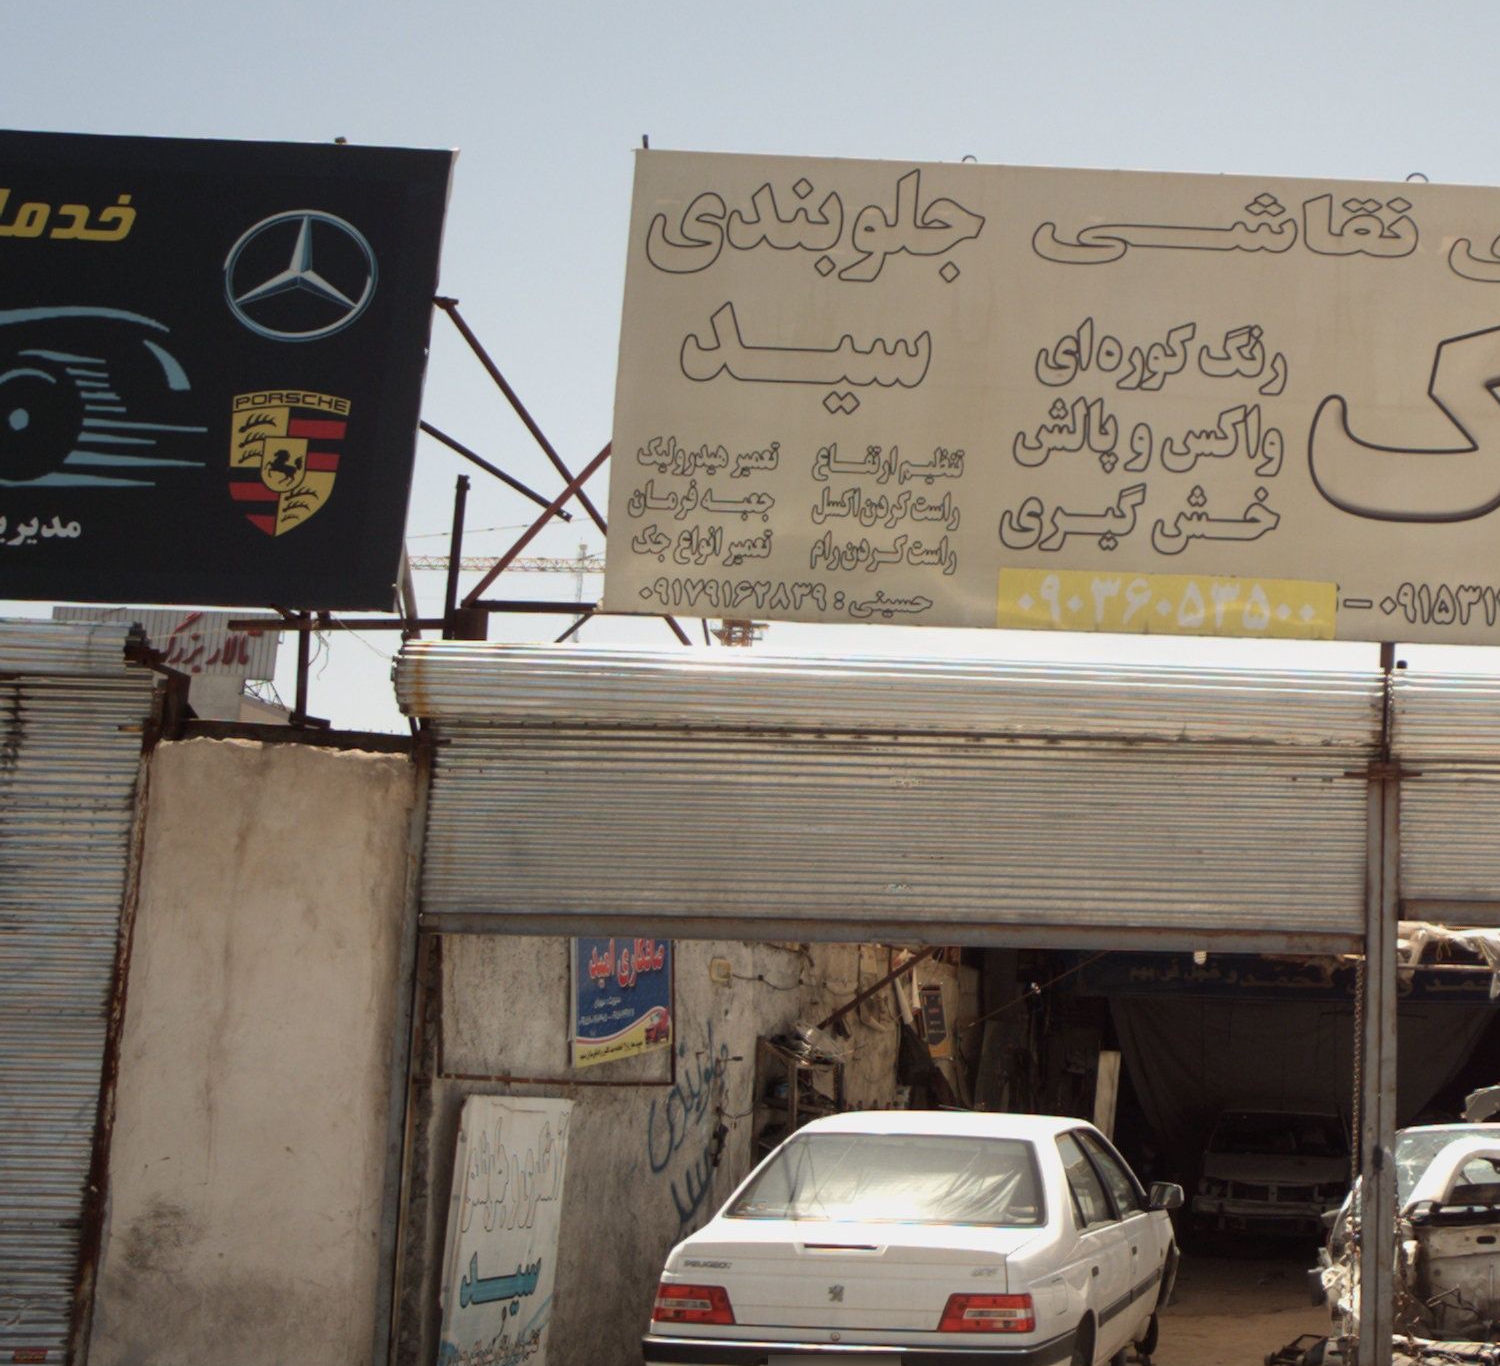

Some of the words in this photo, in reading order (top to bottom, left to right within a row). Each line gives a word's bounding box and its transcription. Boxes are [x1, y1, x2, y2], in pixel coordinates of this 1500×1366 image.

[647, 169, 985, 282] جلوبندی
[1032, 192, 1419, 264] نقاشی
[681, 302, 930, 415] سید
[1199, 325, 1287, 396] رنگ
[236, 392, 348, 413] PORSCHE
[1013, 397, 1119, 473] پالش
[1124, 423, 1153, 472] و
[1161, 404, 1284, 476] واکس
[637, 436, 729, 475] هیدرولیک
[730, 442, 781, 478] تعمیر
[812, 443, 897, 483] ارتفاع
[899, 447, 965, 484] تنظیم
[627, 479, 699, 519] فرمان
[701, 488, 775, 522] جعبه
[811, 487, 860, 525] اکسل
[859, 491, 912, 528] کردن
[910, 492, 960, 530] راست
[999, 483, 1146, 551] گیری
[1152, 486, 1280, 555] خش
[632, 524, 671, 562] جک
[674, 526, 723, 565] انواع
[723, 530, 773, 566] تعمیر
[810, 530, 841, 570] رام
[841, 534, 908, 572] کردن
[907, 536, 957, 574] راست
[639, 577, 826, 610] ۰۹۱۷۹۱۶۲۸۳۹
[1017, 574, 1316, 631] ۰۹۰۳۶۰۵۳۵۰۰
